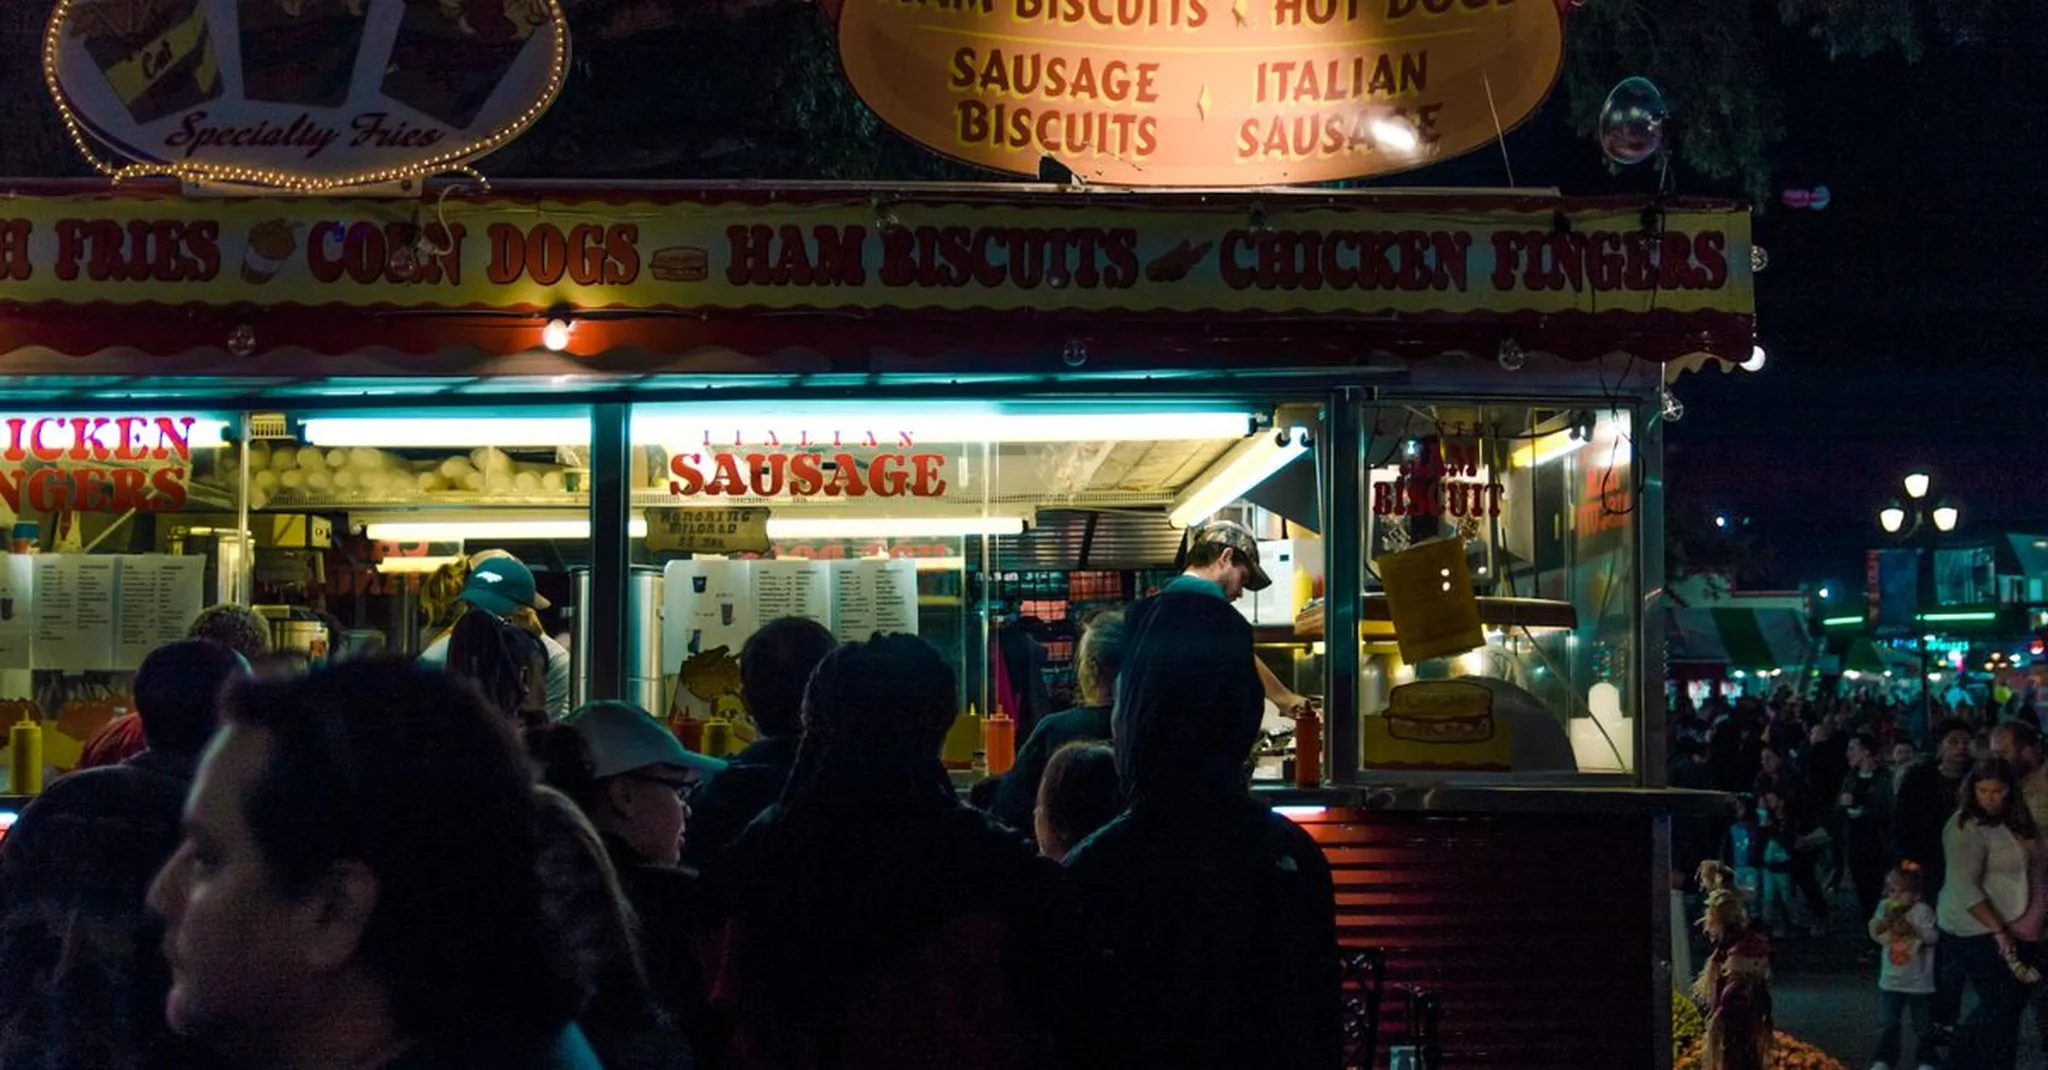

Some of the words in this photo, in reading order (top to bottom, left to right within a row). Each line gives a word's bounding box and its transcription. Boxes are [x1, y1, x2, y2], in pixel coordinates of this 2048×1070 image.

[951, 47, 1160, 103] SAUSAGE
[1256, 50, 1428, 103] ITALIAN
[164, 111, 339, 159] Specialty
[348, 112, 445, 148] Fries
[957, 98, 1158, 156] BISCUITS
[1238, 102, 1443, 158] SAUSAE
[56, 219, 220, 282] FRIES
[487, 221, 640, 286] DOGS
[726, 224, 867, 287] HAM
[878, 226, 1138, 289] BISCUITS
[1218, 228, 1472, 291] CHICKEN
[1491, 228, 1729, 292] FINGERS
[4, 416, 196, 461] ICKEN
[669, 453, 947, 497] SAUSAGE
[1373, 482, 1505, 519] BISCUIT
